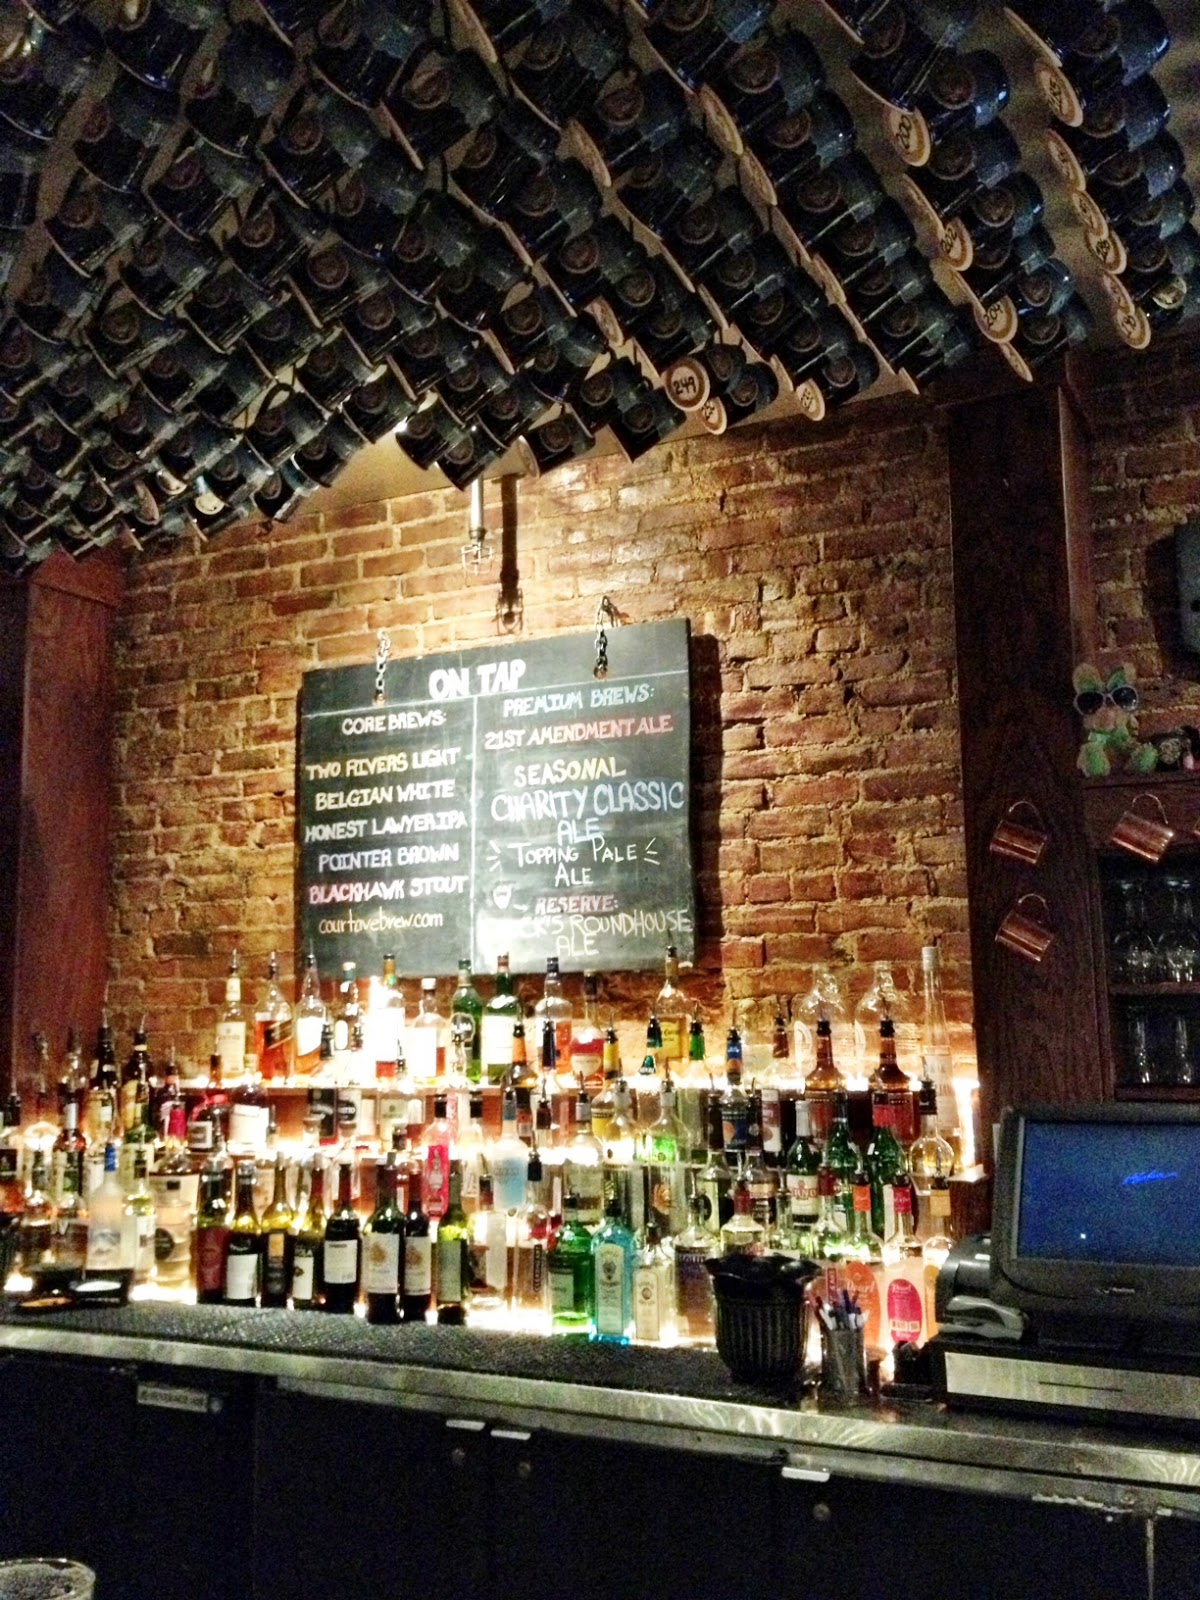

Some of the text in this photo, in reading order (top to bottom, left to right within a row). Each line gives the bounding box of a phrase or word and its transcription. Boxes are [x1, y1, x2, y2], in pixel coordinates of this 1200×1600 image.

[673, 376, 697, 395] 249
[428, 658, 526, 700] ON TAP
[503, 683, 655, 718] PREMIUM BREWS:
[341, 709, 447, 735] CORE BREWS:
[484, 714, 674, 750] 21ST AMENDMENT ALE
[305, 747, 461, 780] TWO RIVERS LIGHT
[513, 756, 627, 788] SEASONAL
[315, 779, 455, 811] BELGIAN WHITE
[490, 781, 685, 822] CHARITY CLASSIC
[304, 819, 368, 843] HONEST
[557, 817, 600, 846] ALE
[318, 843, 460, 873] POINTER BROWN
[554, 862, 594, 887] ALE
[309, 876, 469, 905] BLACKHAWK STOUT
[535, 893, 619, 915] RESERVE:
[318, 905, 443, 934] courtavebrew.com
[569, 908, 693, 938] ROUNDHOUSE
[556, 932, 600, 957] ALE
